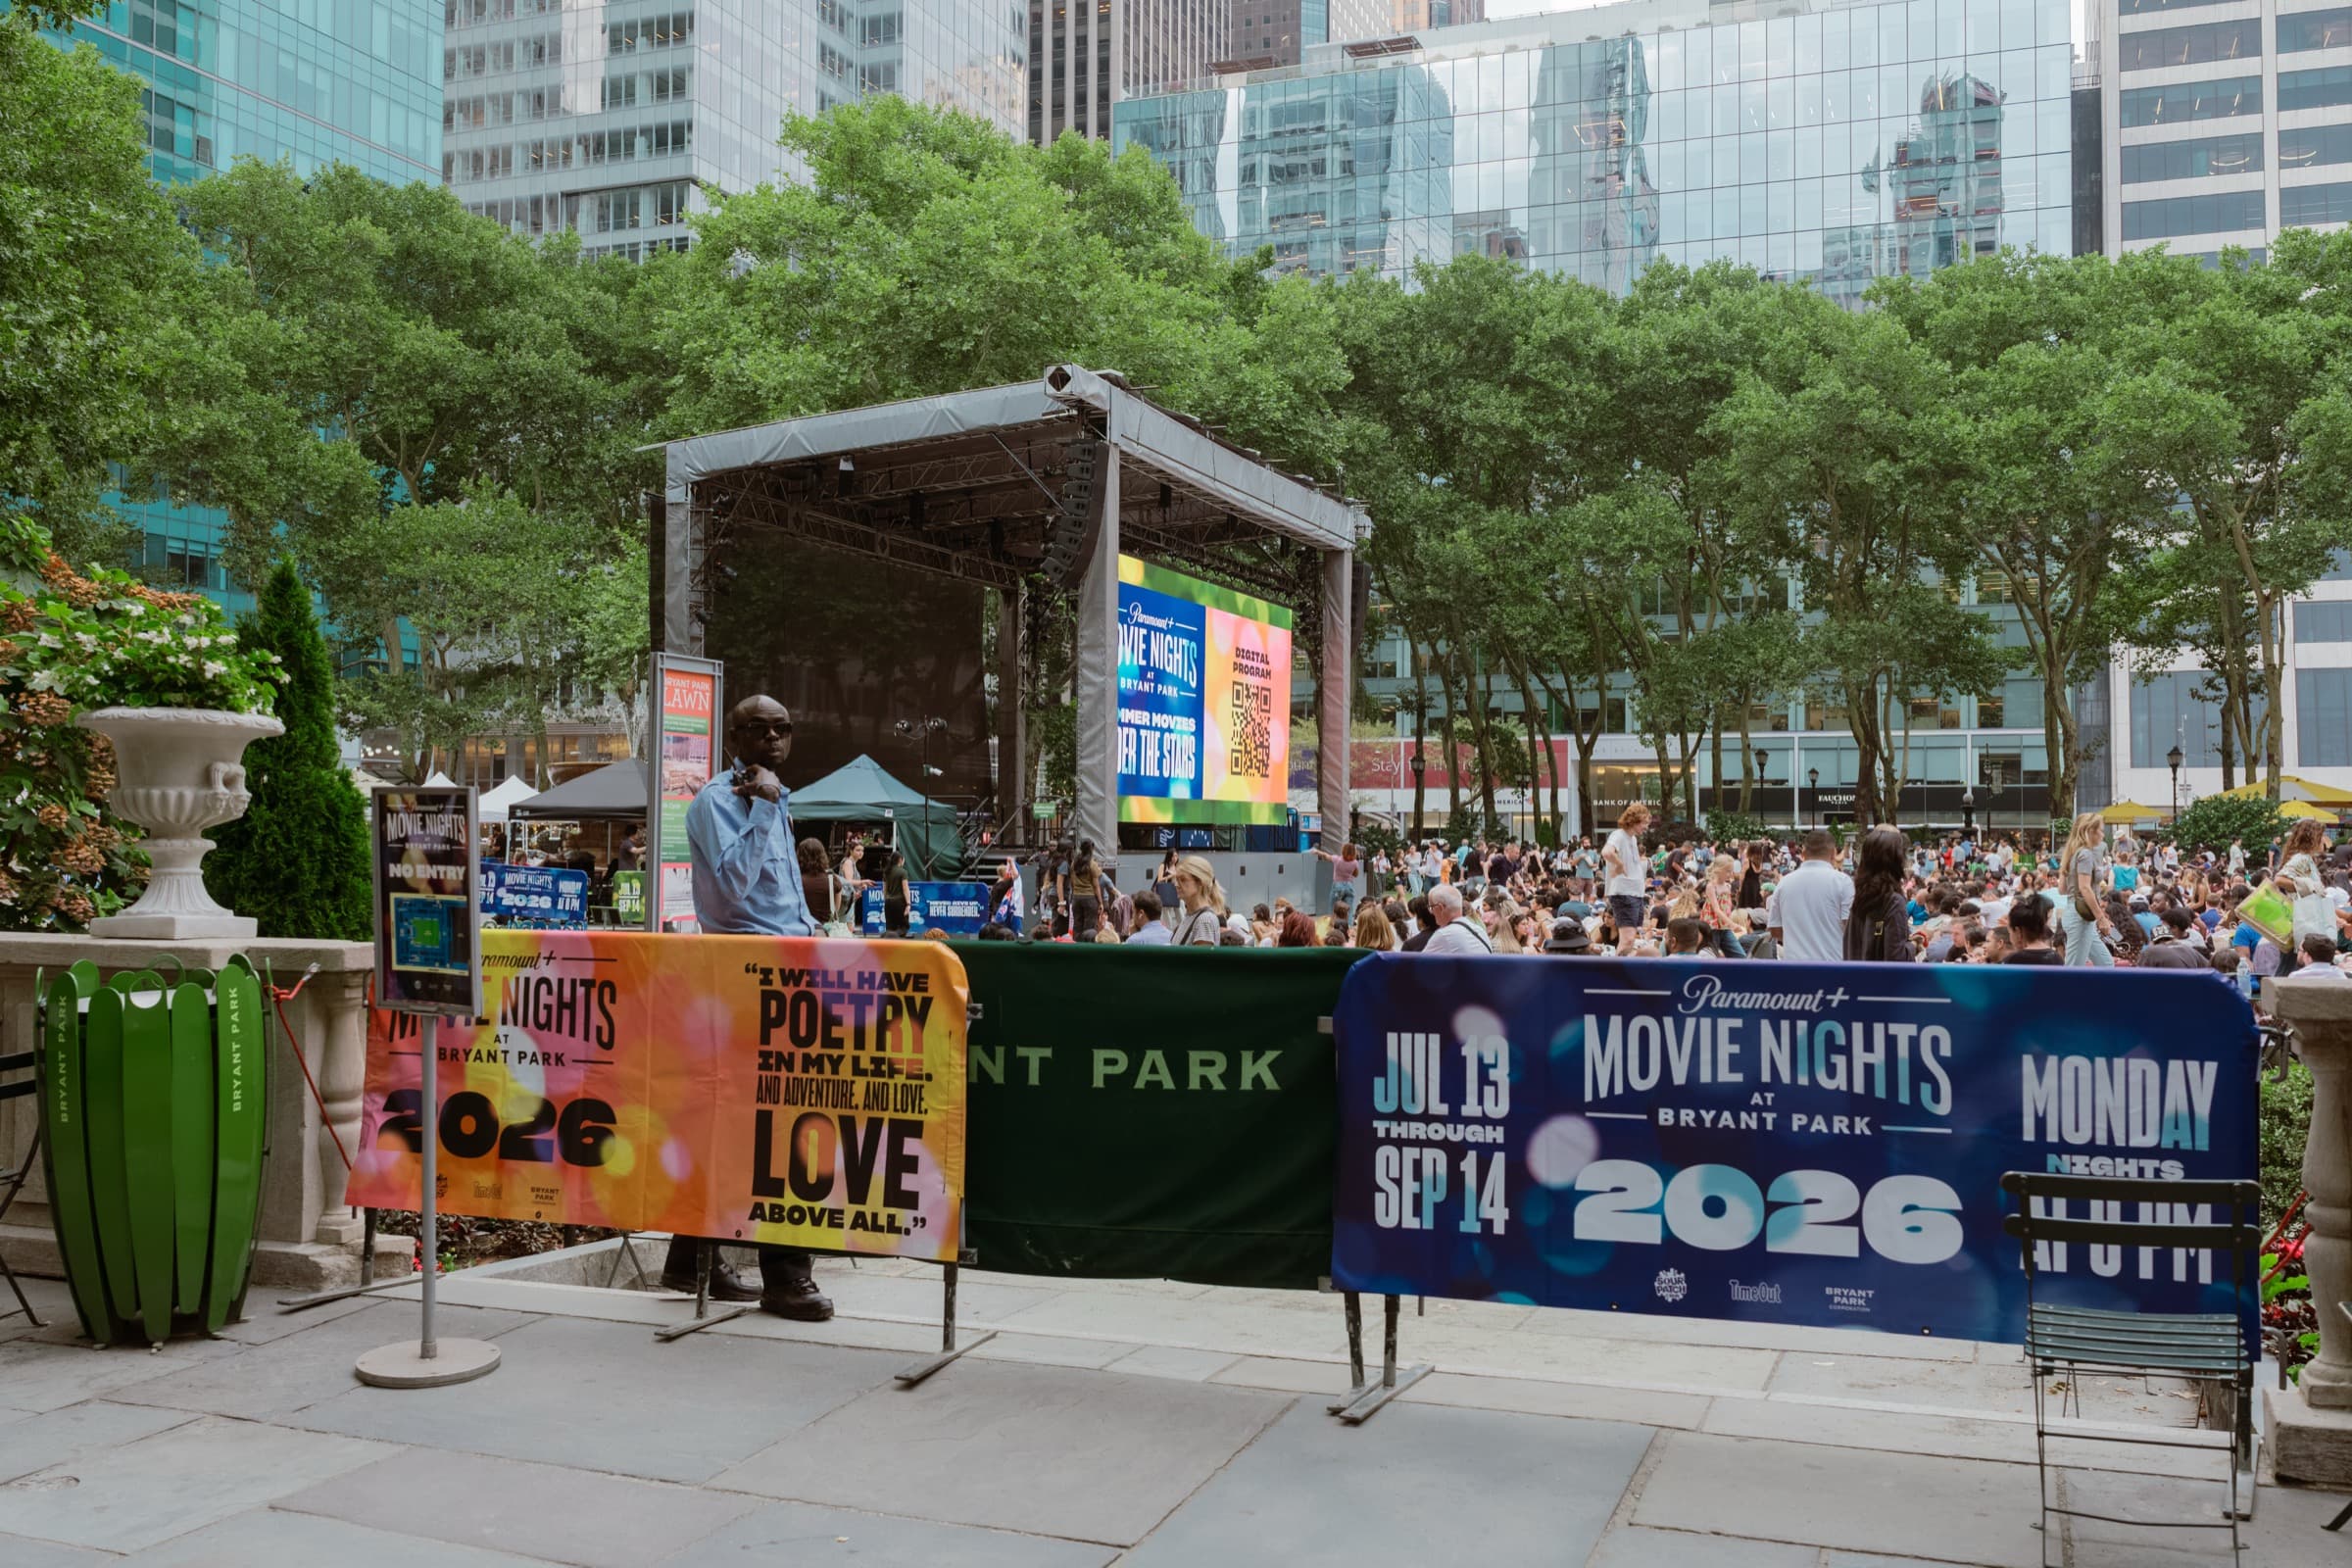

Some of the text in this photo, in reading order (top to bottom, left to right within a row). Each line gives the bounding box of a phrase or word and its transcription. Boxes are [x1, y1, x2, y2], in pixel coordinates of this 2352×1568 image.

[1128, 602, 1174, 630] Paramount+
[1118, 622, 1198, 689] OVIE NIGHTS
[1235, 647, 1269, 665] DIGITAL
[1233, 662, 1271, 680] PROGRAM
[664, 687, 710, 711] LAWN
[1120, 677, 1178, 698] BRYANT PARK
[1152, 712, 1196, 732] MOVIES
[1140, 729, 1160, 777] THE
[1162, 732, 1196, 780] STARS
[387, 813, 466, 844] MOVIE NIGHTS
[389, 863, 466, 880] NO ENTRY
[505, 872, 527, 887] MOVIE
[528, 874, 553, 890] NIGHTS
[501, 893, 553, 909] 2026
[481, 951, 557, 970] ramount+
[779, 968, 852, 989] WILL
[858, 971, 929, 993] HAVE
[1678, 974, 1849, 1014] Paramount+
[501, 976, 616, 1051] NIGHTS
[760, 989, 934, 1054] POETRY
[228, 987, 242, 1112] BRYANT PARK
[494, 1034, 509, 1044] AT
[58, 995, 69, 1122] BRYANT PARK
[438, 1047, 565, 1067] BRYANT PARK
[758, 1051, 933, 1082] IN MY LIFE.
[1092, 1048, 1283, 1091] PARK
[1584, 1014, 1952, 1116] MOVIE NIGHTS
[1373, 1032, 1510, 1119] JUL 13
[756, 1075, 928, 1115] AND ADVENTURE. AND LOVE.
[1750, 1092, 1775, 1106] AT
[2022, 1054, 2219, 1152] MONDAY
[376, 1089, 617, 1167] 2026
[1372, 1120, 1504, 1144] THROUGH
[1658, 1108, 1873, 1135] BRYANT PARK
[752, 1108, 924, 1210] LOVE
[2046, 1153, 2184, 1181] NIGHTS
[1374, 1145, 1509, 1235] SEP 14
[748, 1201, 845, 1230] ABOVE
[1574, 1158, 1964, 1264] 2026
[1656, 1277, 1685, 1286] SOUR
[1656, 1285, 1687, 1295] PATCH
[1825, 1287, 1874, 1298] BRYANT
[1834, 1296, 1867, 1305] PARK
